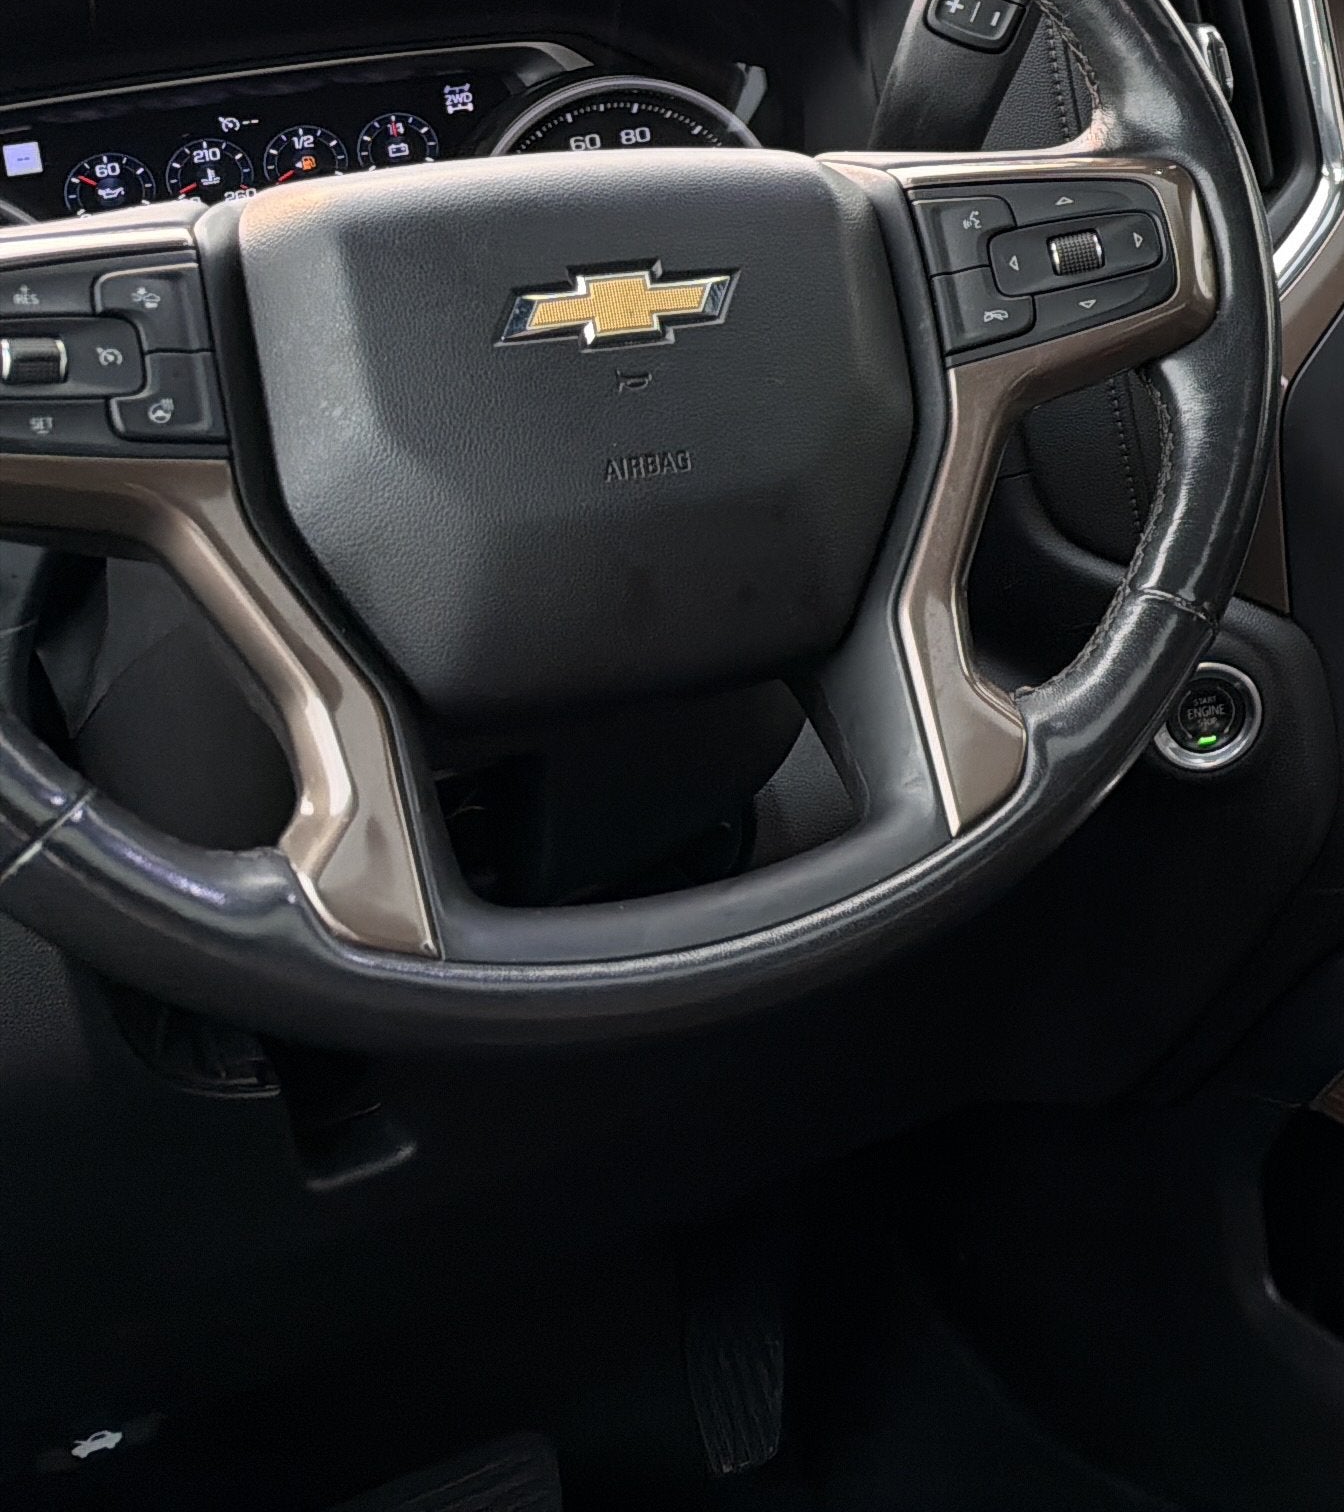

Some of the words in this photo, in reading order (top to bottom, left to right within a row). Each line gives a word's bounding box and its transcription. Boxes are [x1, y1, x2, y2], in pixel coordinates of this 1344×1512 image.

[444, 92, 473, 105] 2WD
[291, 134, 315, 150] 1/2
[569, 133, 602, 151] 60
[620, 127, 651, 145] 80
[193, 148, 221, 163] 210
[95, 162, 121, 178] 60
[29, 417, 53, 430] SET
[605, 450, 692, 484] AIRBAG
[1193, 695, 1217, 706] START
[1187, 704, 1226, 720] ENGINE
